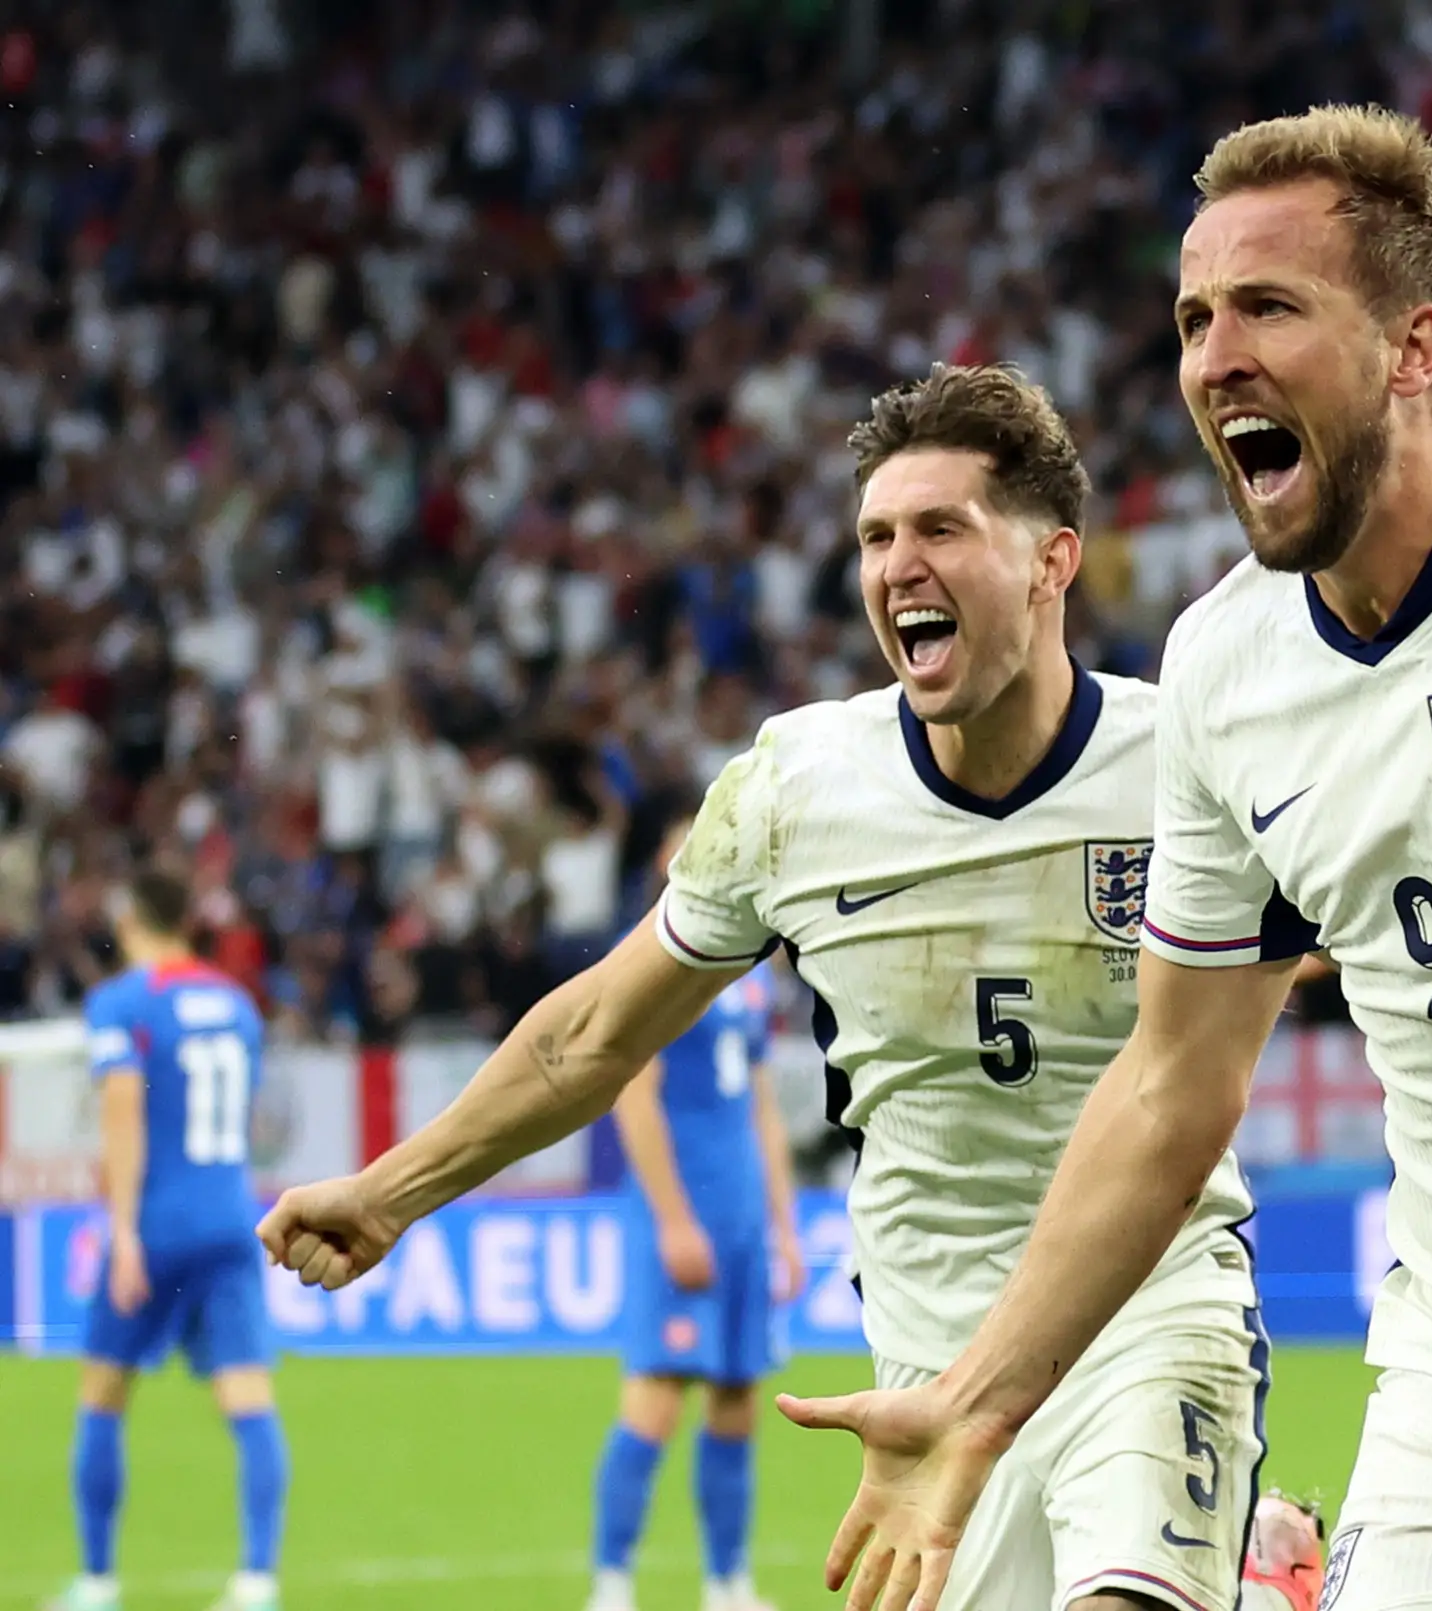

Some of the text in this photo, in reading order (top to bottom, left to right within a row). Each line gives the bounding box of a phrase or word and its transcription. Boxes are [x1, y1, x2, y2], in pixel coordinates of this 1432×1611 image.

[976, 977, 1038, 1088] 5
[177, 1032, 250, 1166] 11
[1178, 1399, 1225, 1520] 5
